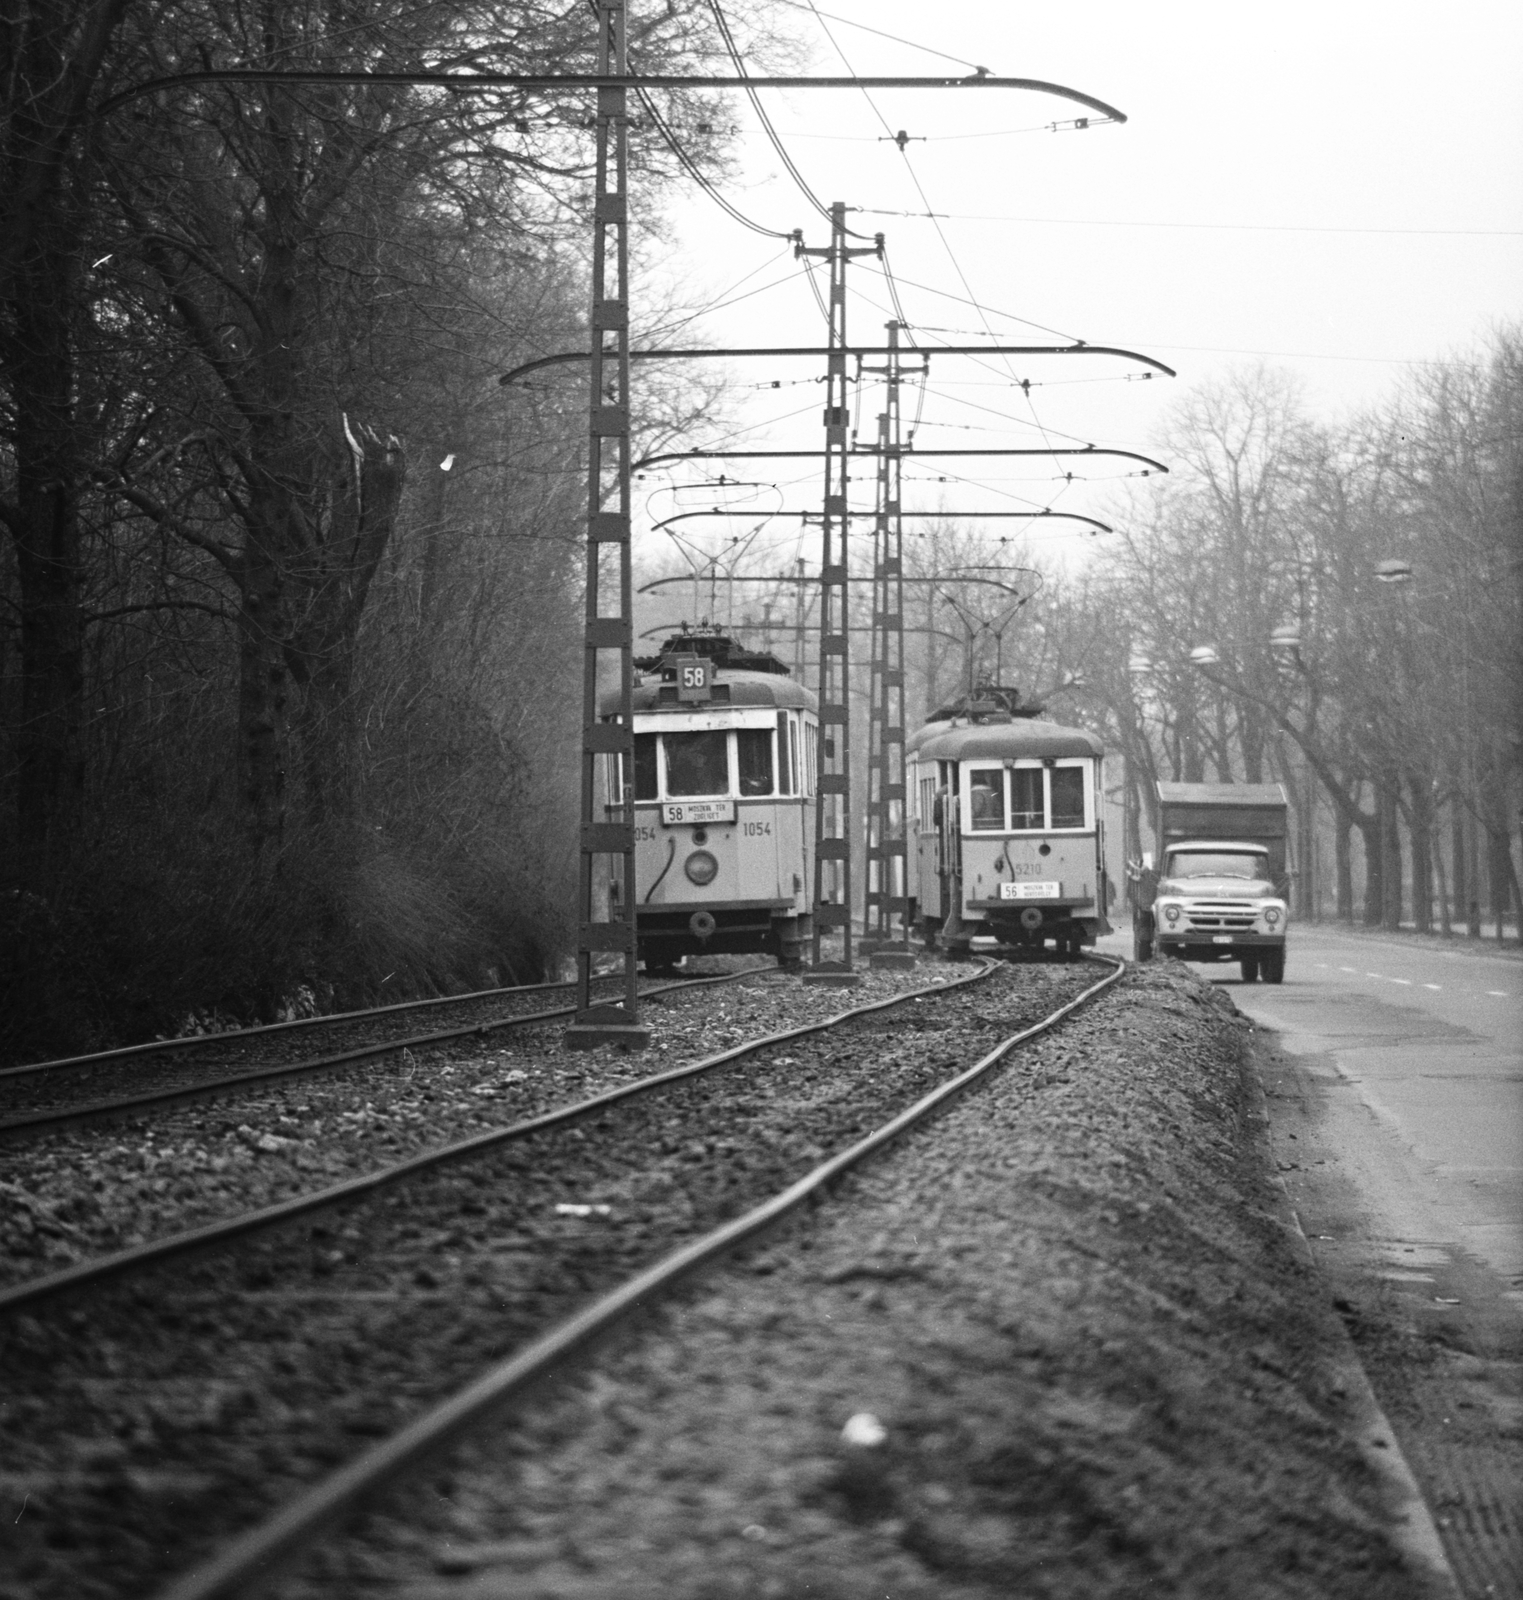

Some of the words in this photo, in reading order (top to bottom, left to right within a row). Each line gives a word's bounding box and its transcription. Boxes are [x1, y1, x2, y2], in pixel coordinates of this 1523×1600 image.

[684, 667, 704, 687] 58
[669, 807, 683, 821] 58
[634, 827, 656, 841] 054
[743, 822, 771, 836] 1054
[1016, 863, 1042, 875] 5210
[1005, 886, 1018, 897] 56
